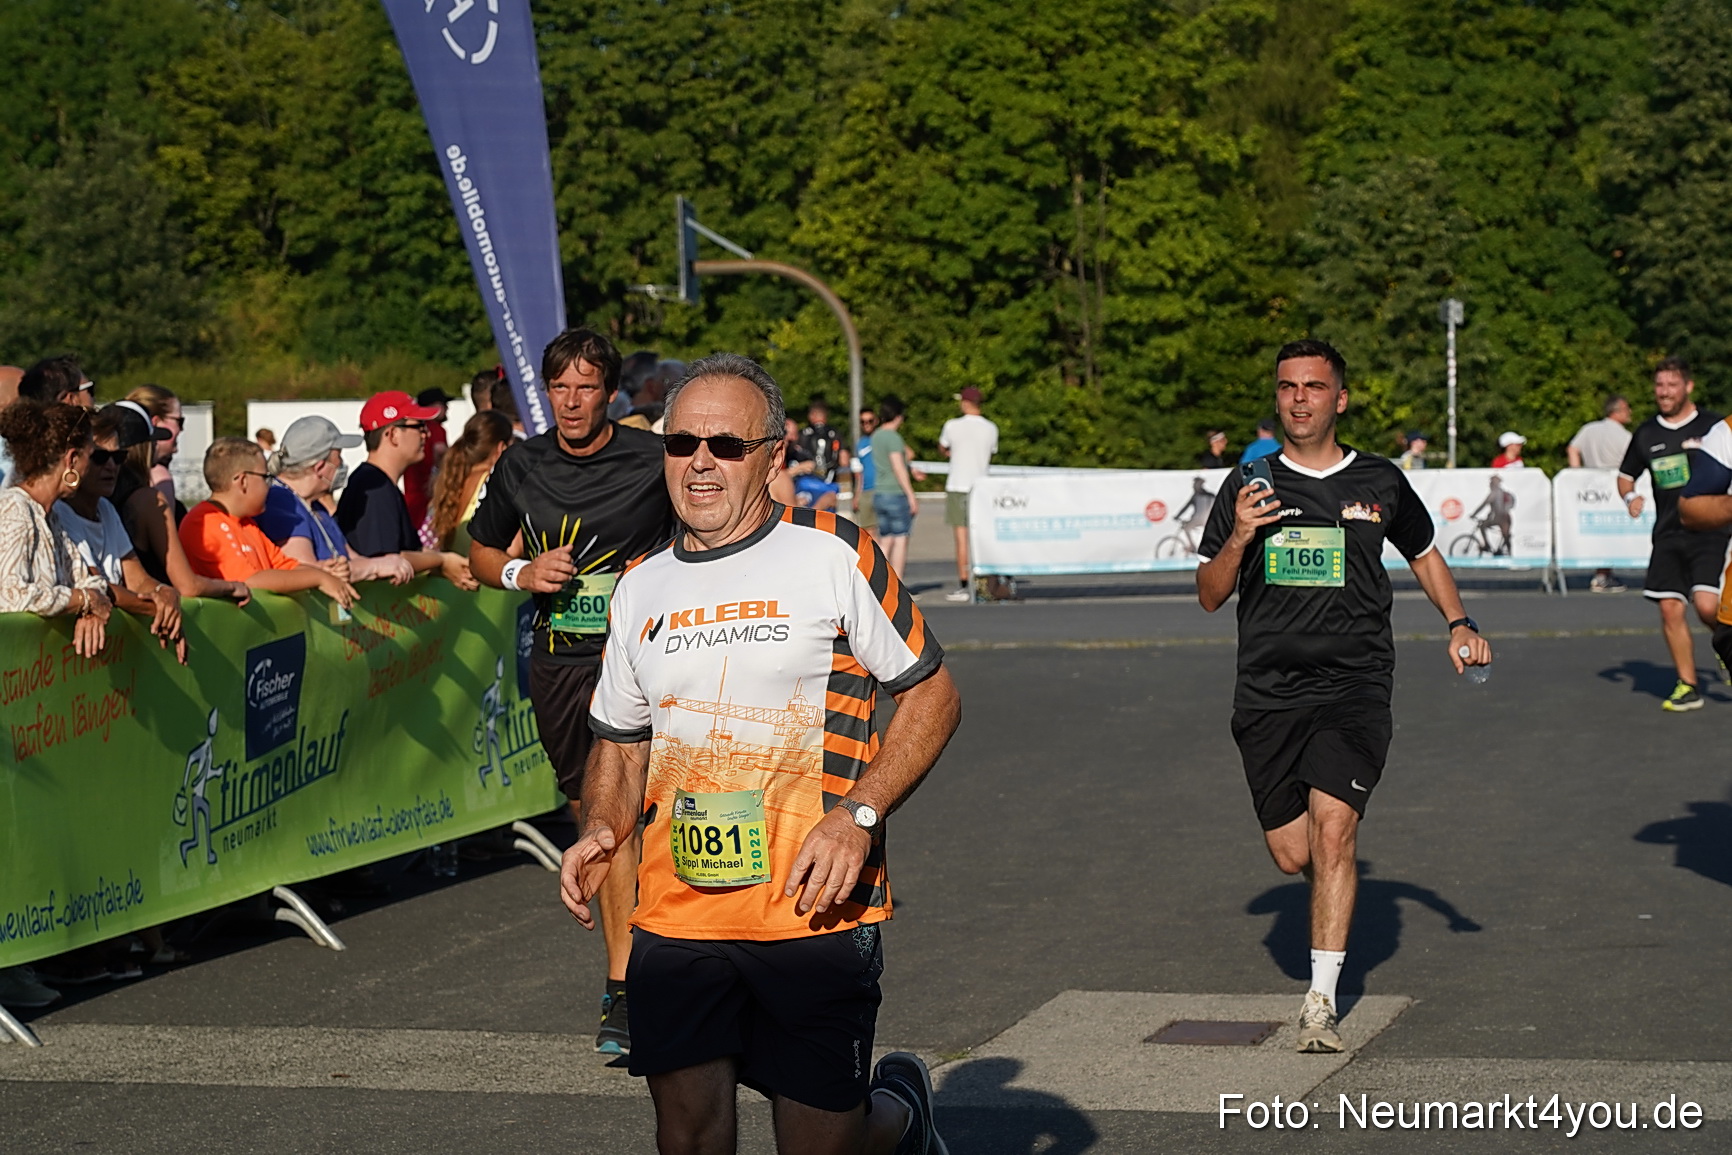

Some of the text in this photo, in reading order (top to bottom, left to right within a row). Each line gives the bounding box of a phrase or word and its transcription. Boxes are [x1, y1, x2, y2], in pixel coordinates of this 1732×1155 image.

[1269, 552, 1277, 574] RUN
[1285, 547, 1325, 567] 166
[1301, 567, 1328, 577] Philipp
[1333, 551, 1341, 579] 2022
[569, 595, 606, 614] 660
[669, 600, 790, 631] KLEBL
[664, 623, 790, 655] DYNAMICS
[256, 671, 295, 701] Fischer
[71, 667, 138, 743] länger!
[220, 709, 350, 825] firmenlauf
[223, 811, 277, 853] neumarkt
[672, 824, 681, 868] WALK
[679, 823, 742, 855] 1081
[681, 856, 744, 870] Sippl Michael
[748, 827, 763, 870] 2022
